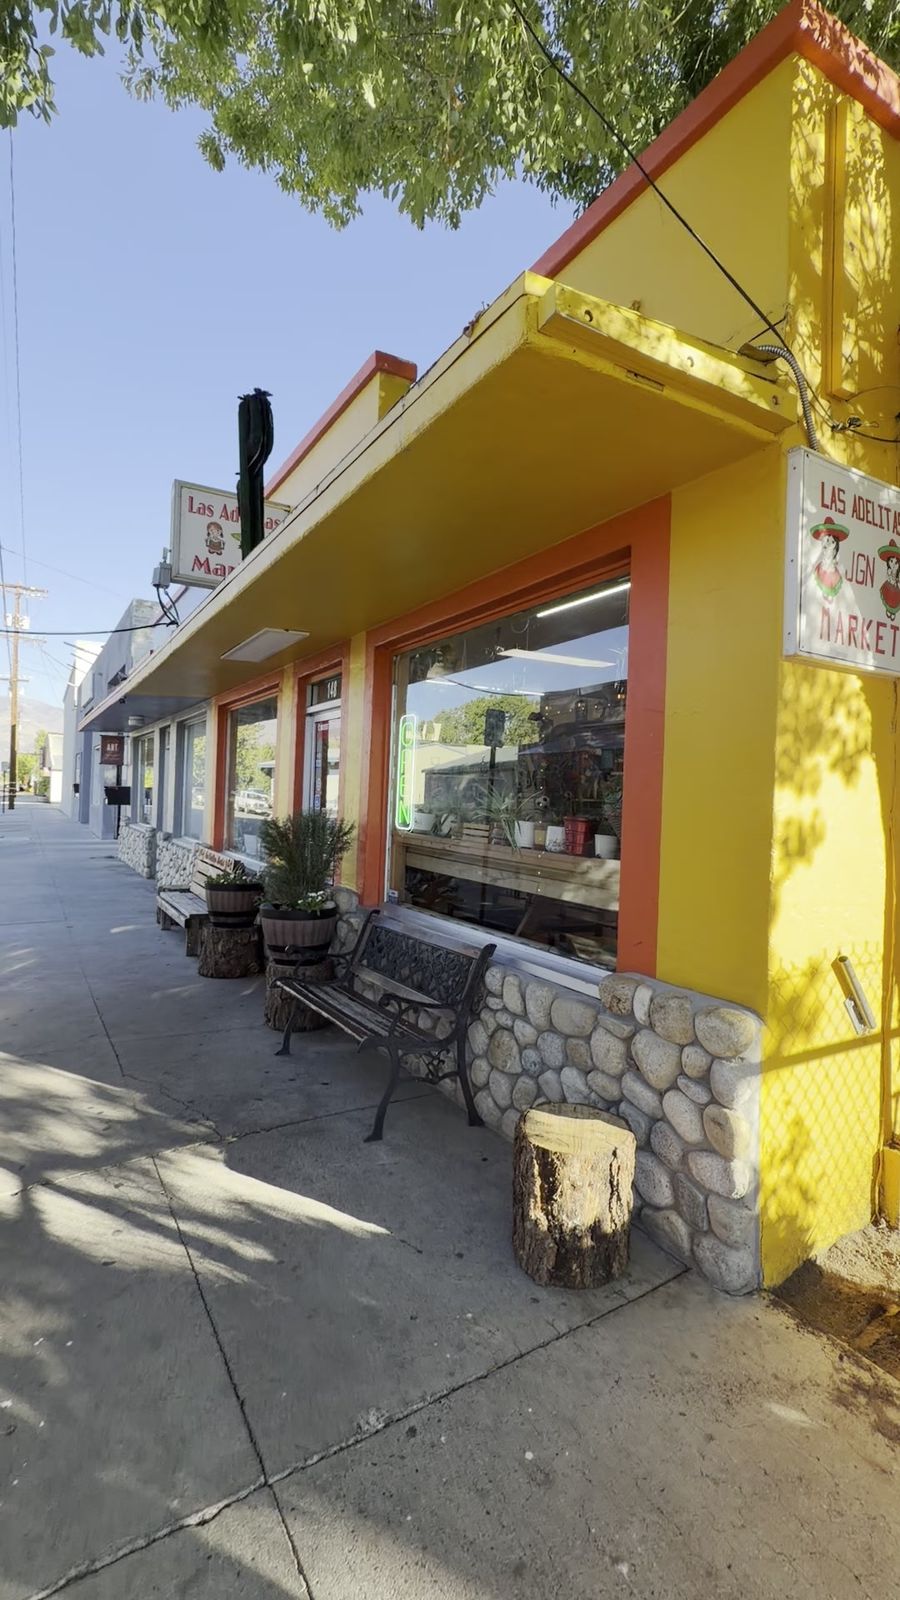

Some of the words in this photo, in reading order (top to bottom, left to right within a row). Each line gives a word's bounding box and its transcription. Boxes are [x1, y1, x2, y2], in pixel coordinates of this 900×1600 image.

[187, 495, 214, 518] Las
[219, 503, 281, 530] Adas
[820, 481, 846, 515] LAS
[192, 555, 235, 577] Mar
[845, 551, 876, 588] JGN
[820, 606, 900, 657] MARKET
